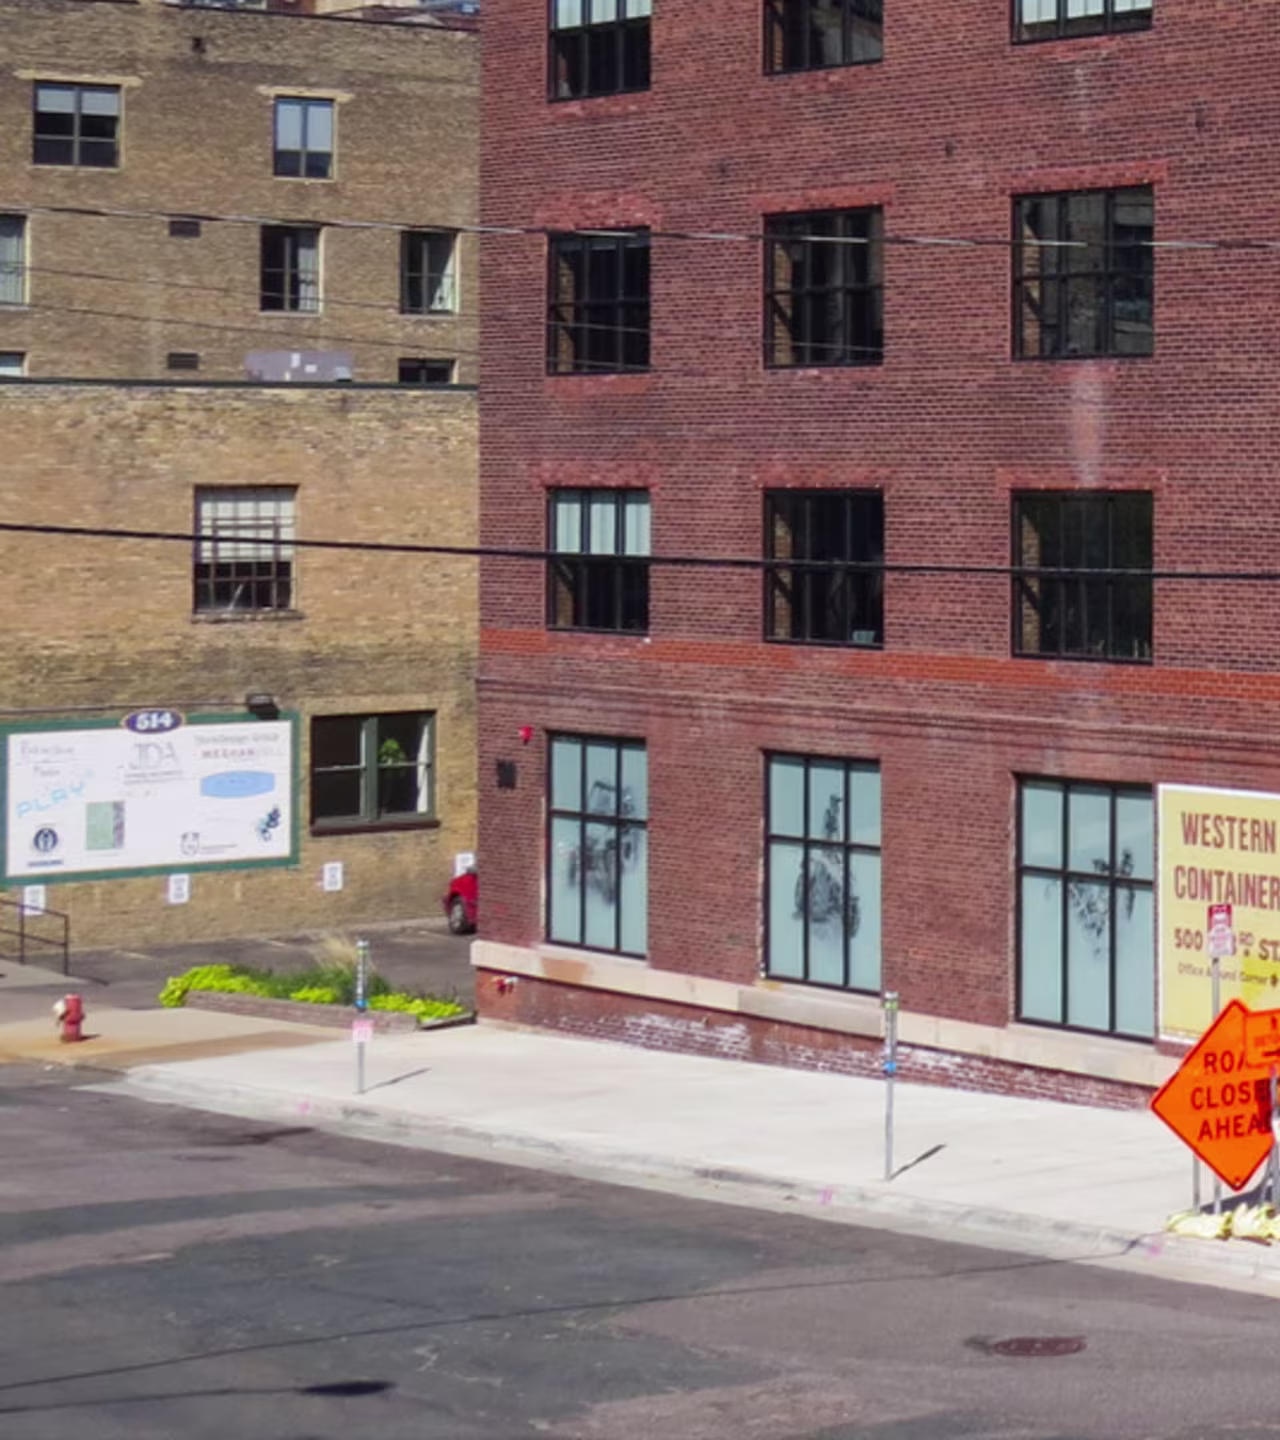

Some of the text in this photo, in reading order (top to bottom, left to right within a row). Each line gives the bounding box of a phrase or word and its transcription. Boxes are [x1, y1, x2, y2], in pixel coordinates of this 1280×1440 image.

[1181, 811, 1277, 854] WESTERN
[1174, 928, 1203, 952] 500
[1177, 961, 1204, 976] Office
[1203, 1050, 1246, 1075] ROA
[1191, 1079, 1270, 1110] CLOSE
[1197, 1112, 1271, 1142] AHEA
